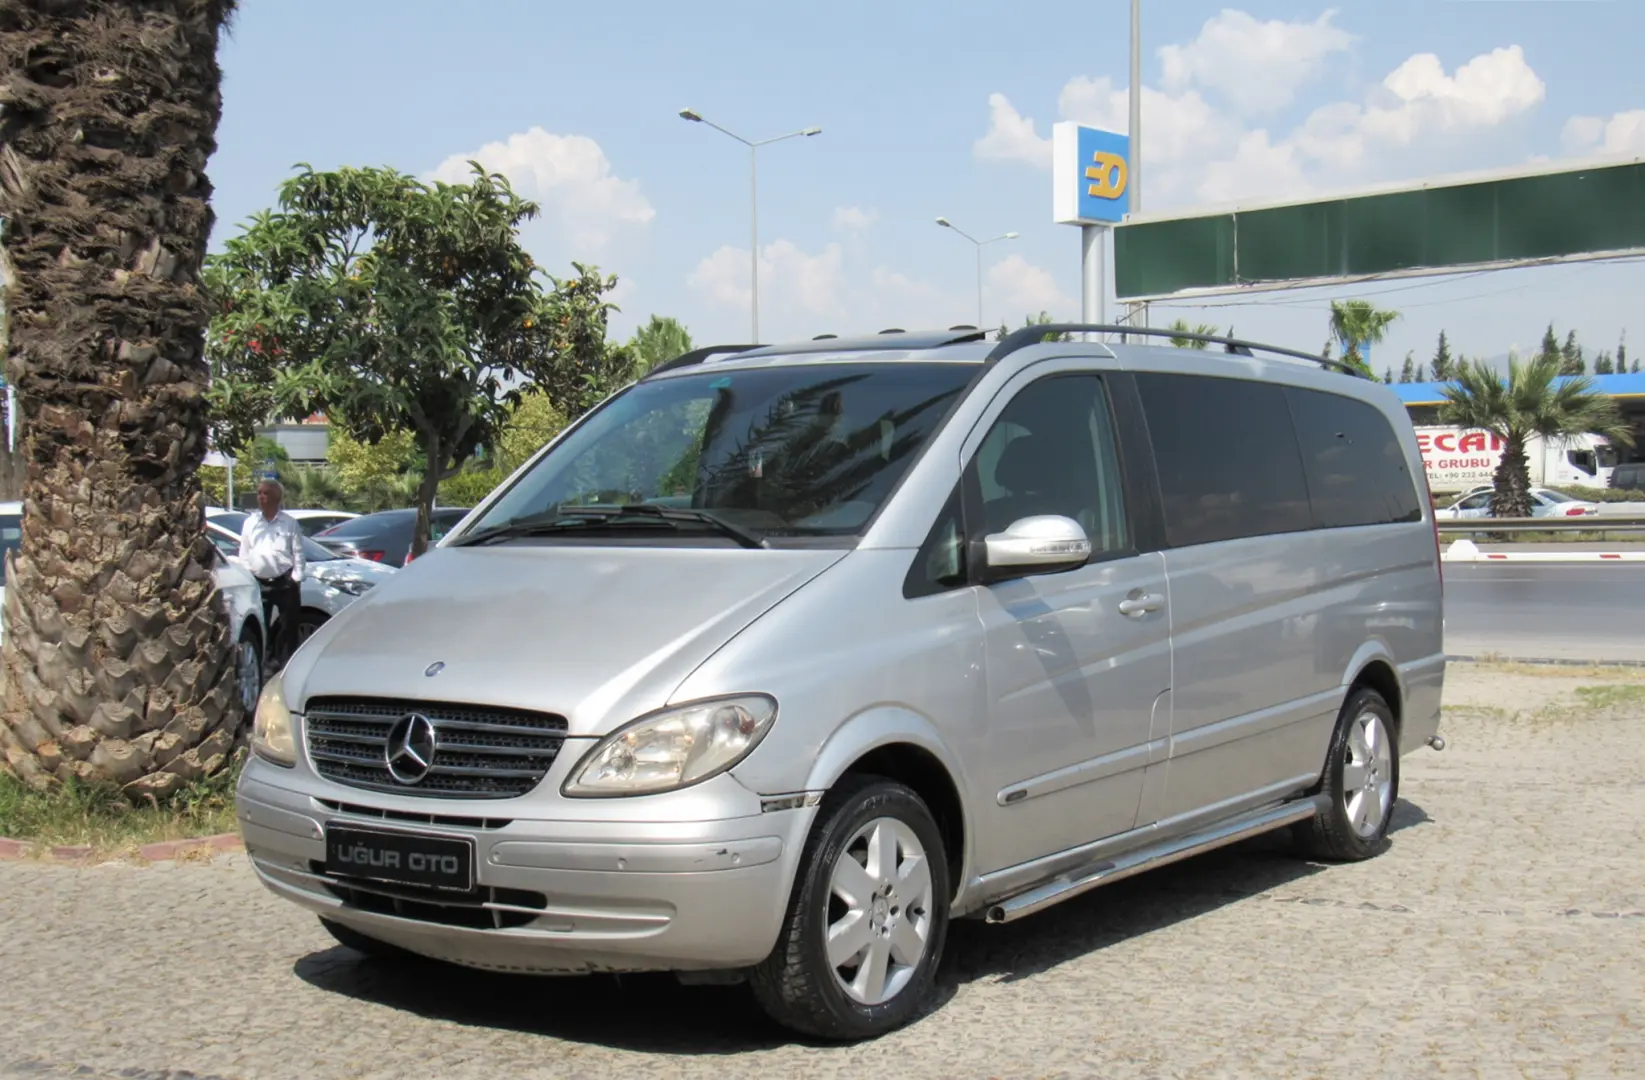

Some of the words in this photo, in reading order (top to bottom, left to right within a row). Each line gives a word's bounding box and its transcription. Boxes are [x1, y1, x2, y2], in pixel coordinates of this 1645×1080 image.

[1438, 458, 1490, 469] GRUBU
[1444, 471, 1459, 479] +90
[337, 841, 400, 868] UĞUR
[408, 853, 459, 874] OTO
